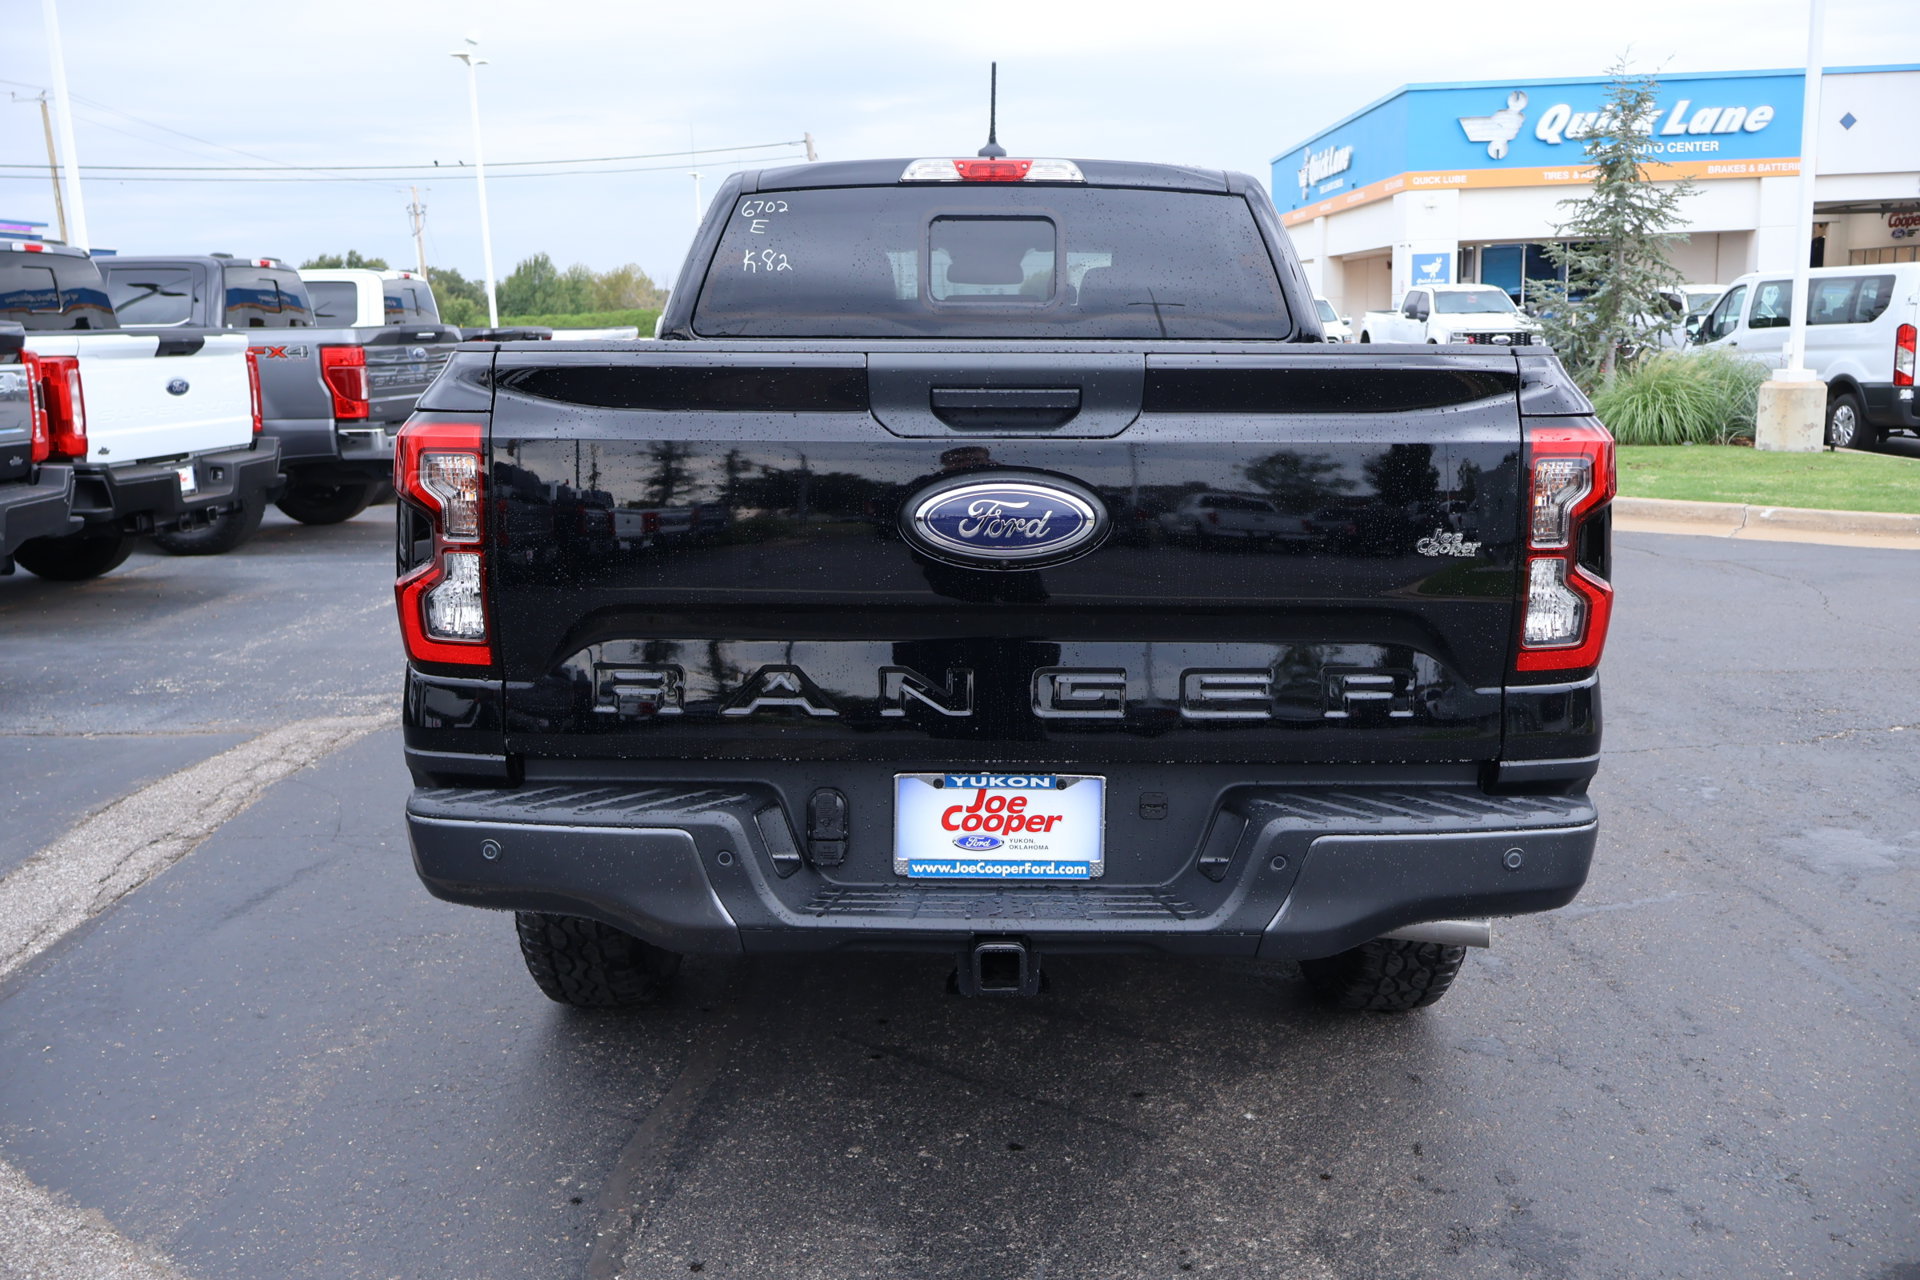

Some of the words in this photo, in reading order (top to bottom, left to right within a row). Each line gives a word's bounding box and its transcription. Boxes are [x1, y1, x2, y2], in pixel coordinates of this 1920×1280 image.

[1660, 100, 1775, 136] Lane
[1666, 140, 1720, 154] CENTER
[1543, 171, 1570, 181] TIRES
[1707, 163, 1747, 174] BRAKES
[1757, 162, 1801, 172] BATTERI
[1412, 176, 1442, 185] QUICK
[1442, 175, 1468, 185] LUBE
[741, 200, 788, 218] 6702
[749, 219, 769, 234] E
[958, 499, 1053, 539] Ford
[1431, 528, 1463, 544] Joe
[1416, 537, 1482, 556] Cooper
[593, 662, 1416, 719] RANGER
[950, 776, 1050, 788] YUKON
[966, 788, 1028, 814] Joe
[941, 804, 1063, 836] Cooper
[965, 836, 992, 848] Ford
[912, 861, 1088, 877] www.JoeCooperFord.com
